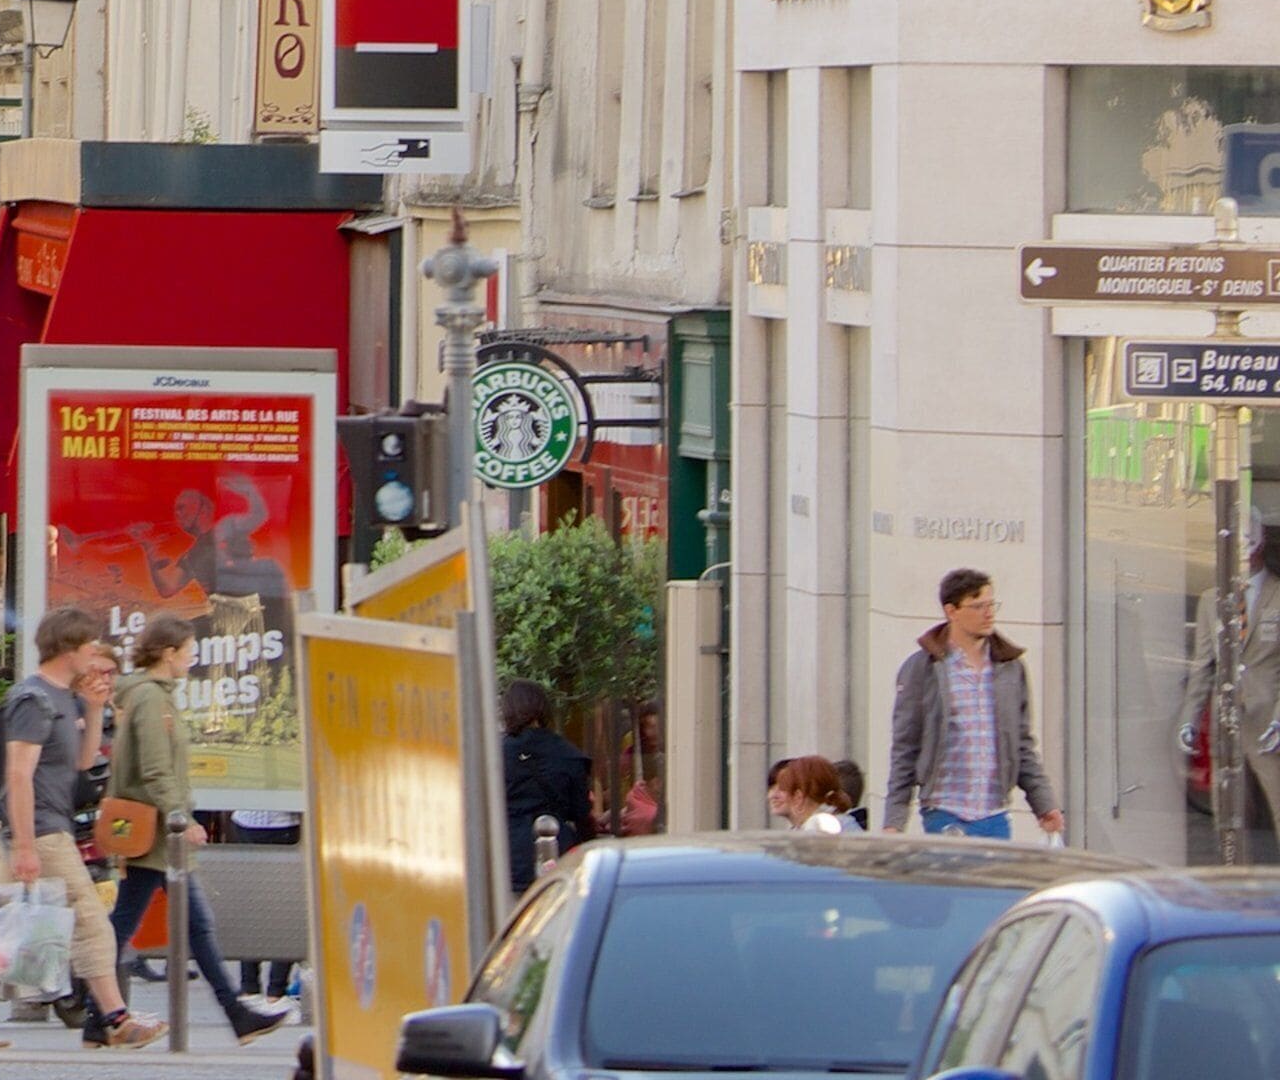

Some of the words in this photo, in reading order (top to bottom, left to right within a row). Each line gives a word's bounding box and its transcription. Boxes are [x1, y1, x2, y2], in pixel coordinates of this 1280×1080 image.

[1098, 256, 1165, 272] QUARTIER
[1167, 257, 1225, 273] PIETONS
[1221, 280, 1264, 296] DENIS
[1201, 350, 1279, 371] Bureau
[153, 376, 209, 388] JCDecaux
[1232, 376, 1268, 392] Rue
[60, 406, 122, 432] 16-17
[132, 408, 184, 421] FESTIVAL
[186, 409, 209, 421] DES
[210, 410, 240, 422] ARTS
[242, 410, 257, 422] DE
[259, 410, 274, 422] LA
[276, 410, 300, 423] RUE
[62, 436, 106, 458] MAI
[474, 451, 558, 482] COFFEE
[110, 606, 146, 636] Le
